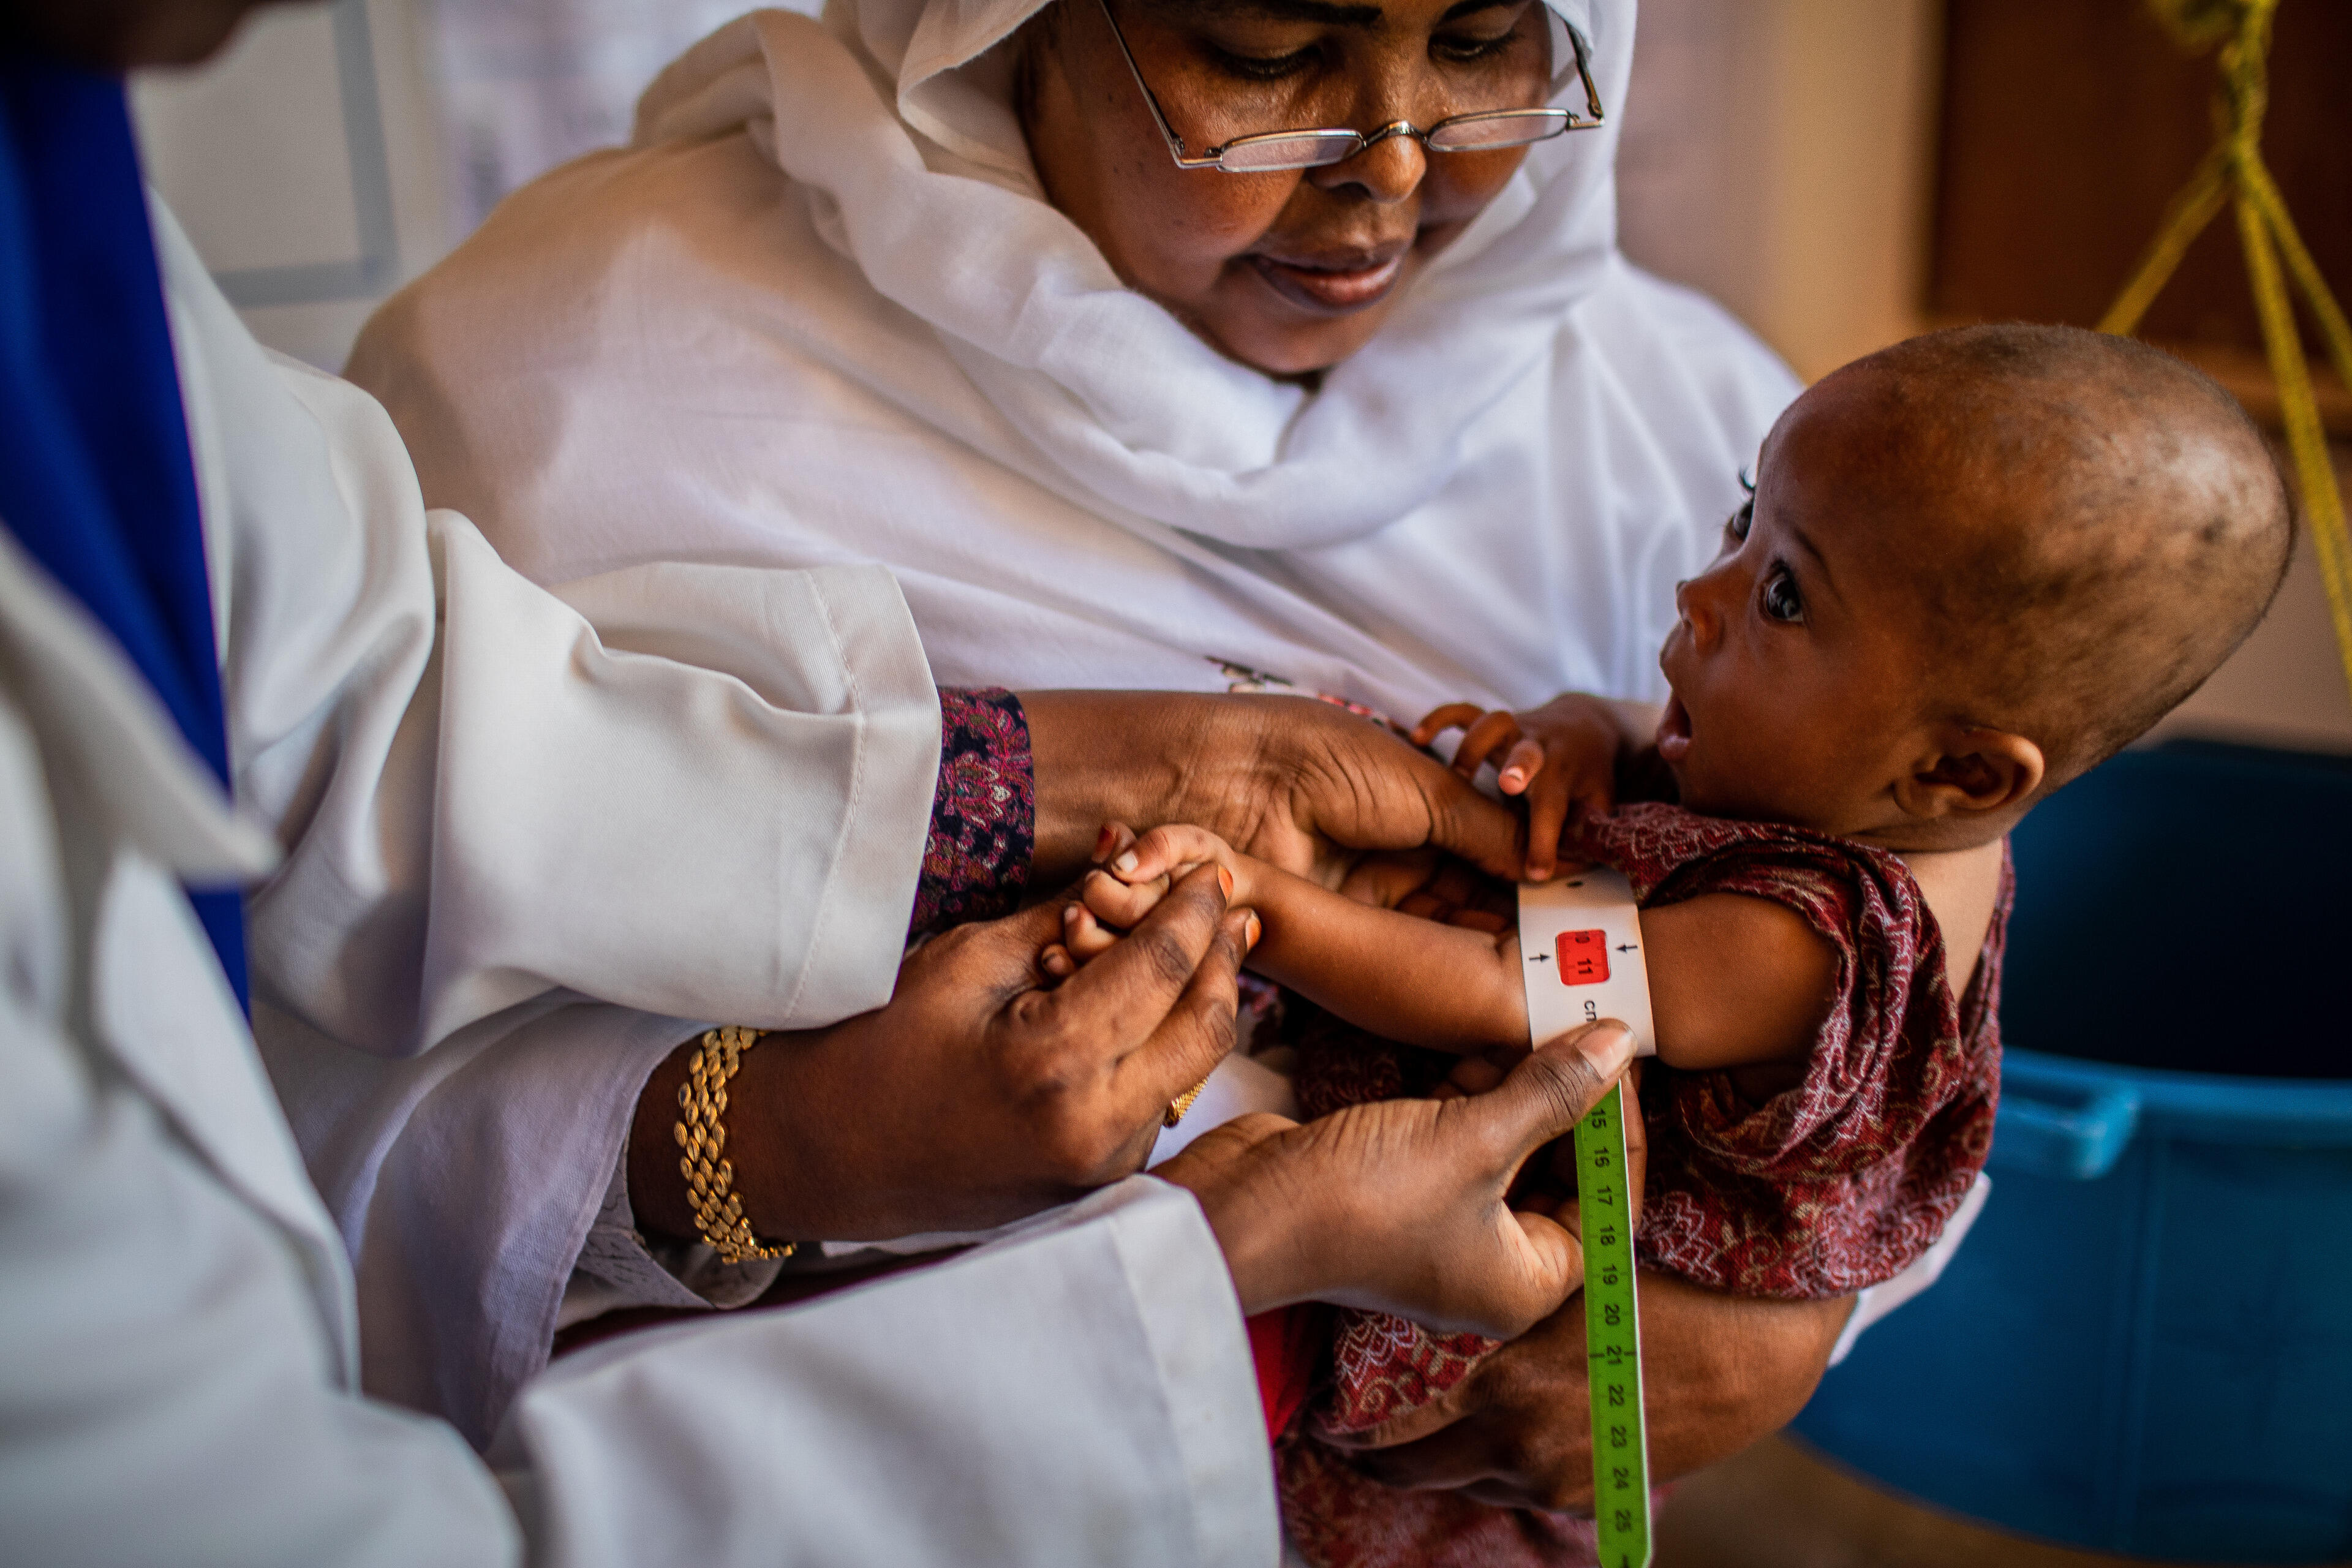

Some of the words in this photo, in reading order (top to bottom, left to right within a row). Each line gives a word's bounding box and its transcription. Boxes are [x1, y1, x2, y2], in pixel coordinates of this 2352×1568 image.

[1577, 958, 1593, 974] 11
[1591, 1108, 1607, 1129] 15
[1594, 1147, 1610, 1167] 16
[1597, 1186, 1612, 1207] 17
[1600, 1224, 1615, 1246] 18
[1603, 1264, 1618, 1285] 19
[1604, 1304, 1620, 1325] 20
[1606, 1346, 1621, 1365] 21
[1608, 1385, 1624, 1407] 22
[1611, 1426, 1627, 1448] 23
[1613, 1467, 1629, 1489] 24
[1615, 1509, 1632, 1532] 25
